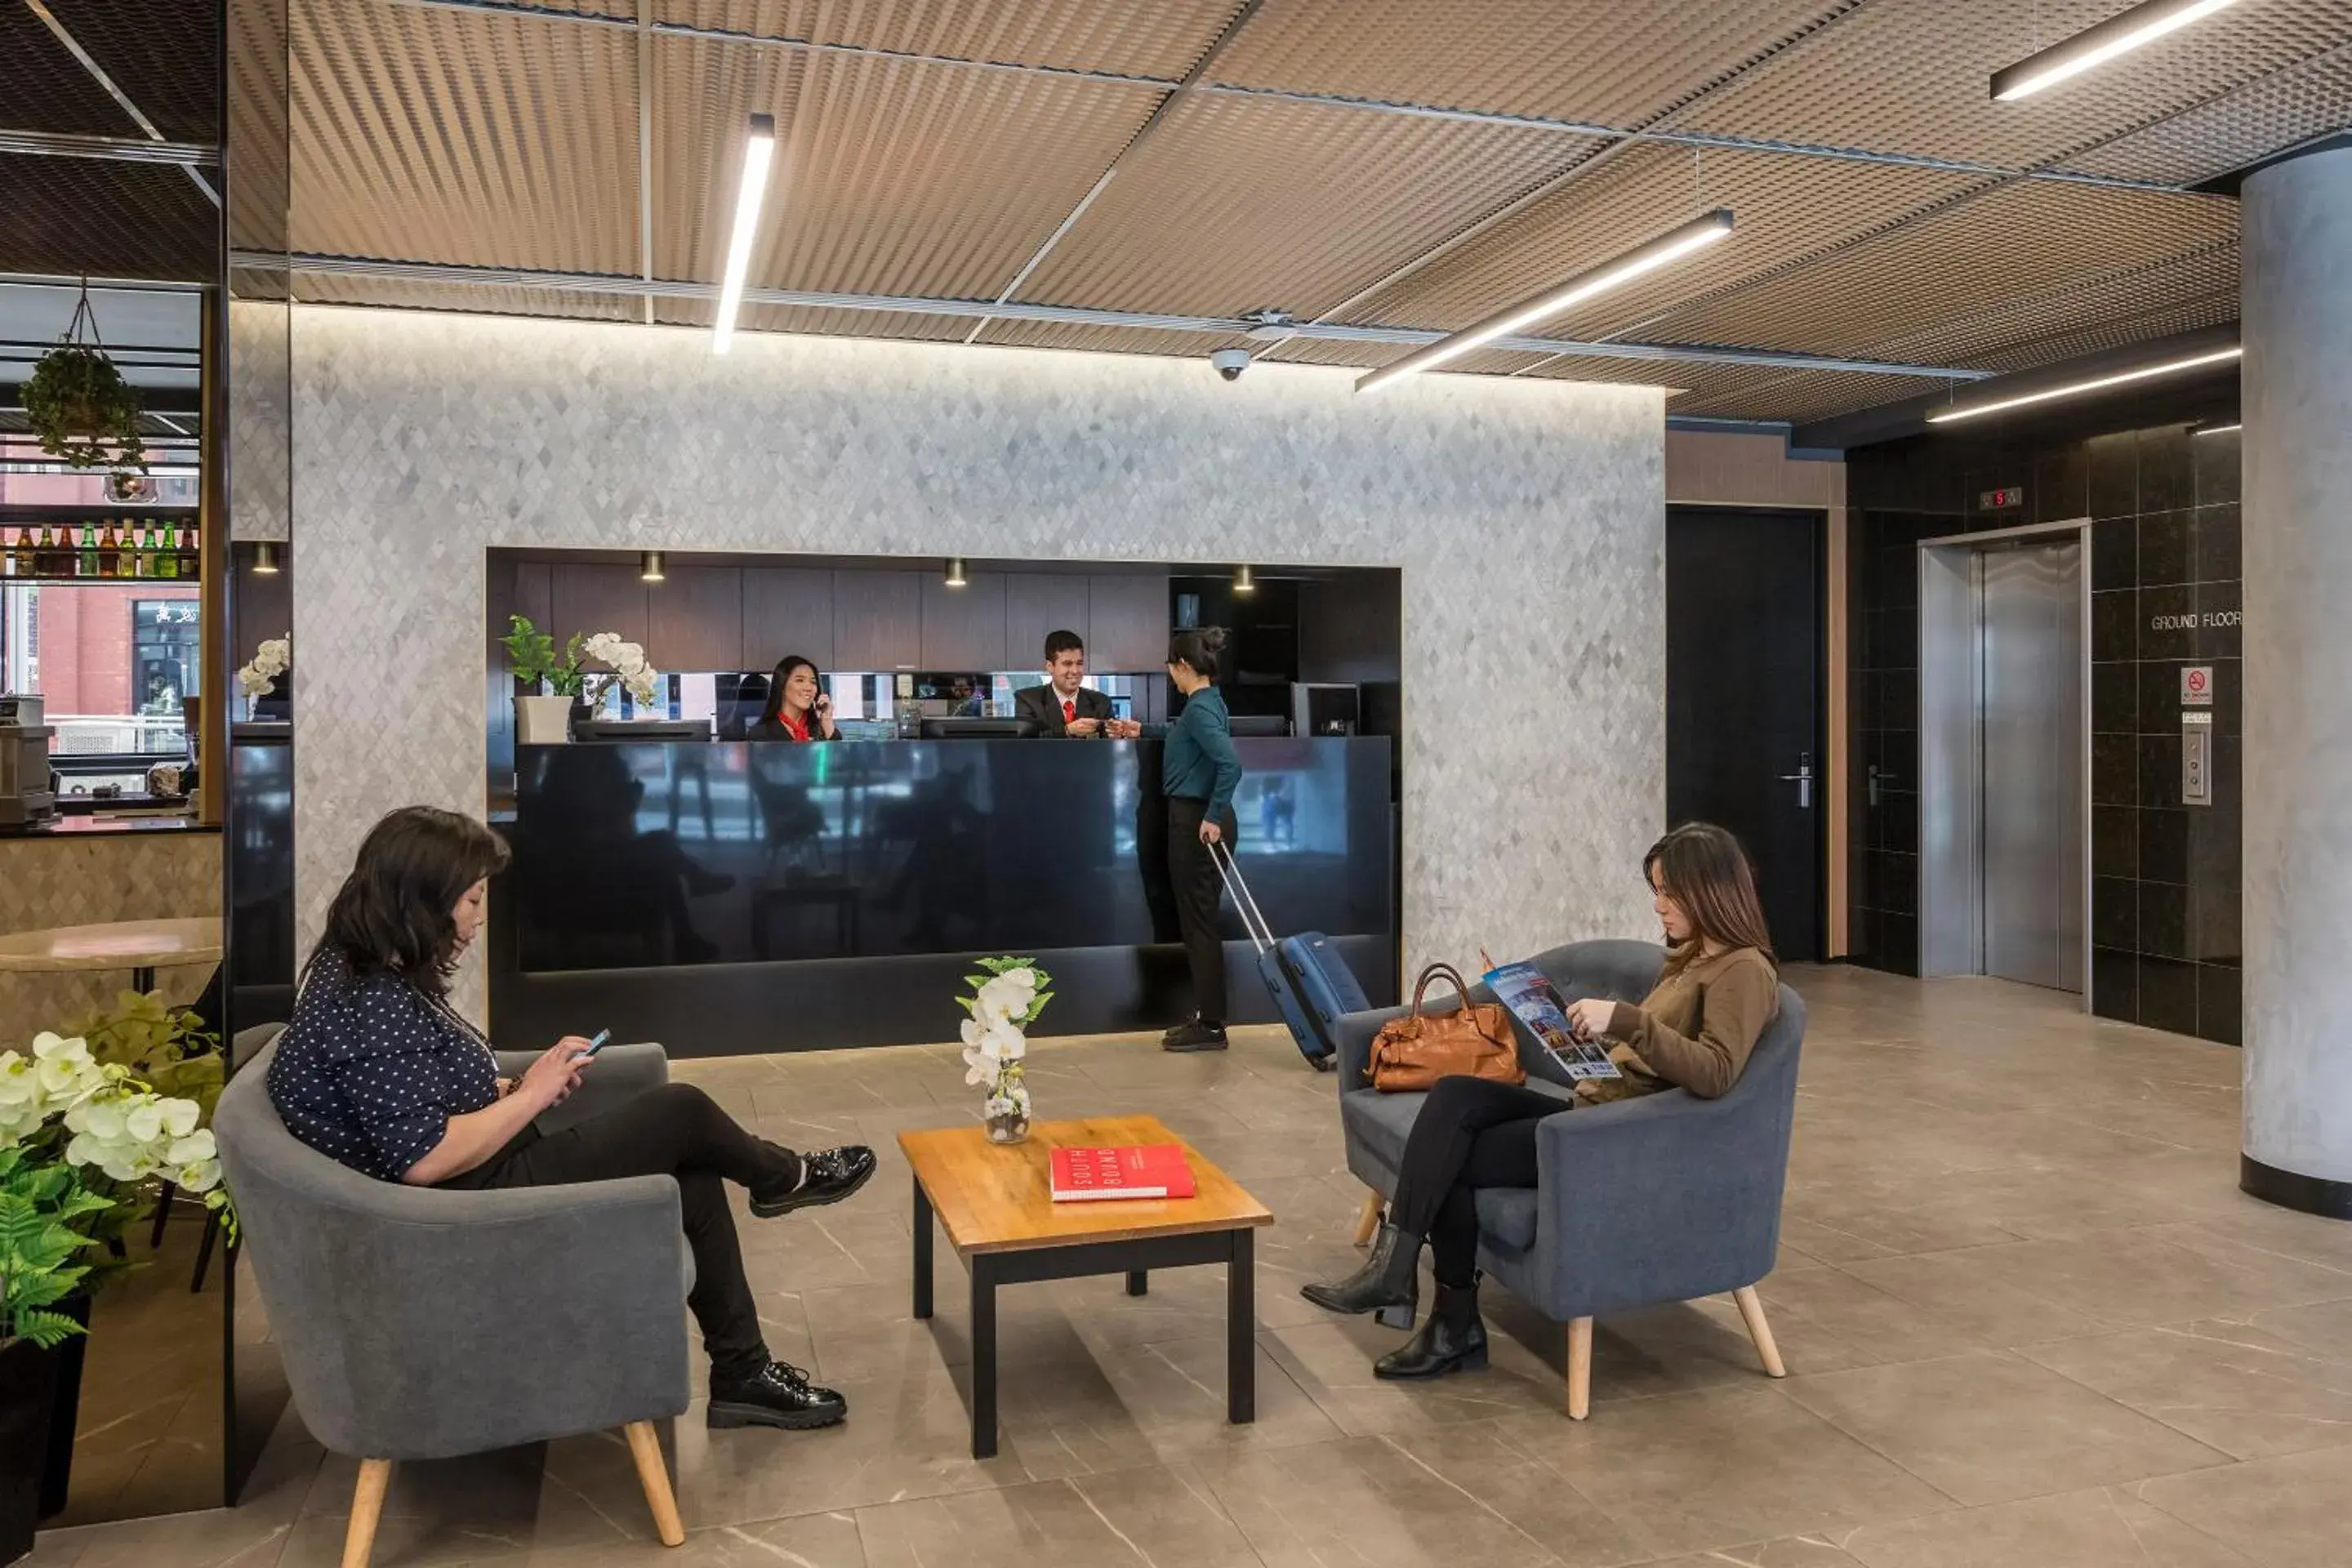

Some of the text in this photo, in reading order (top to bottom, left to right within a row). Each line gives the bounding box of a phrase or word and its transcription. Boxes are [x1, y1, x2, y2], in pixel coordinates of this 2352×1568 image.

[2151, 611, 2242, 630] GROUND FLOOR
[1070, 1150, 1093, 1185] SOUTH
